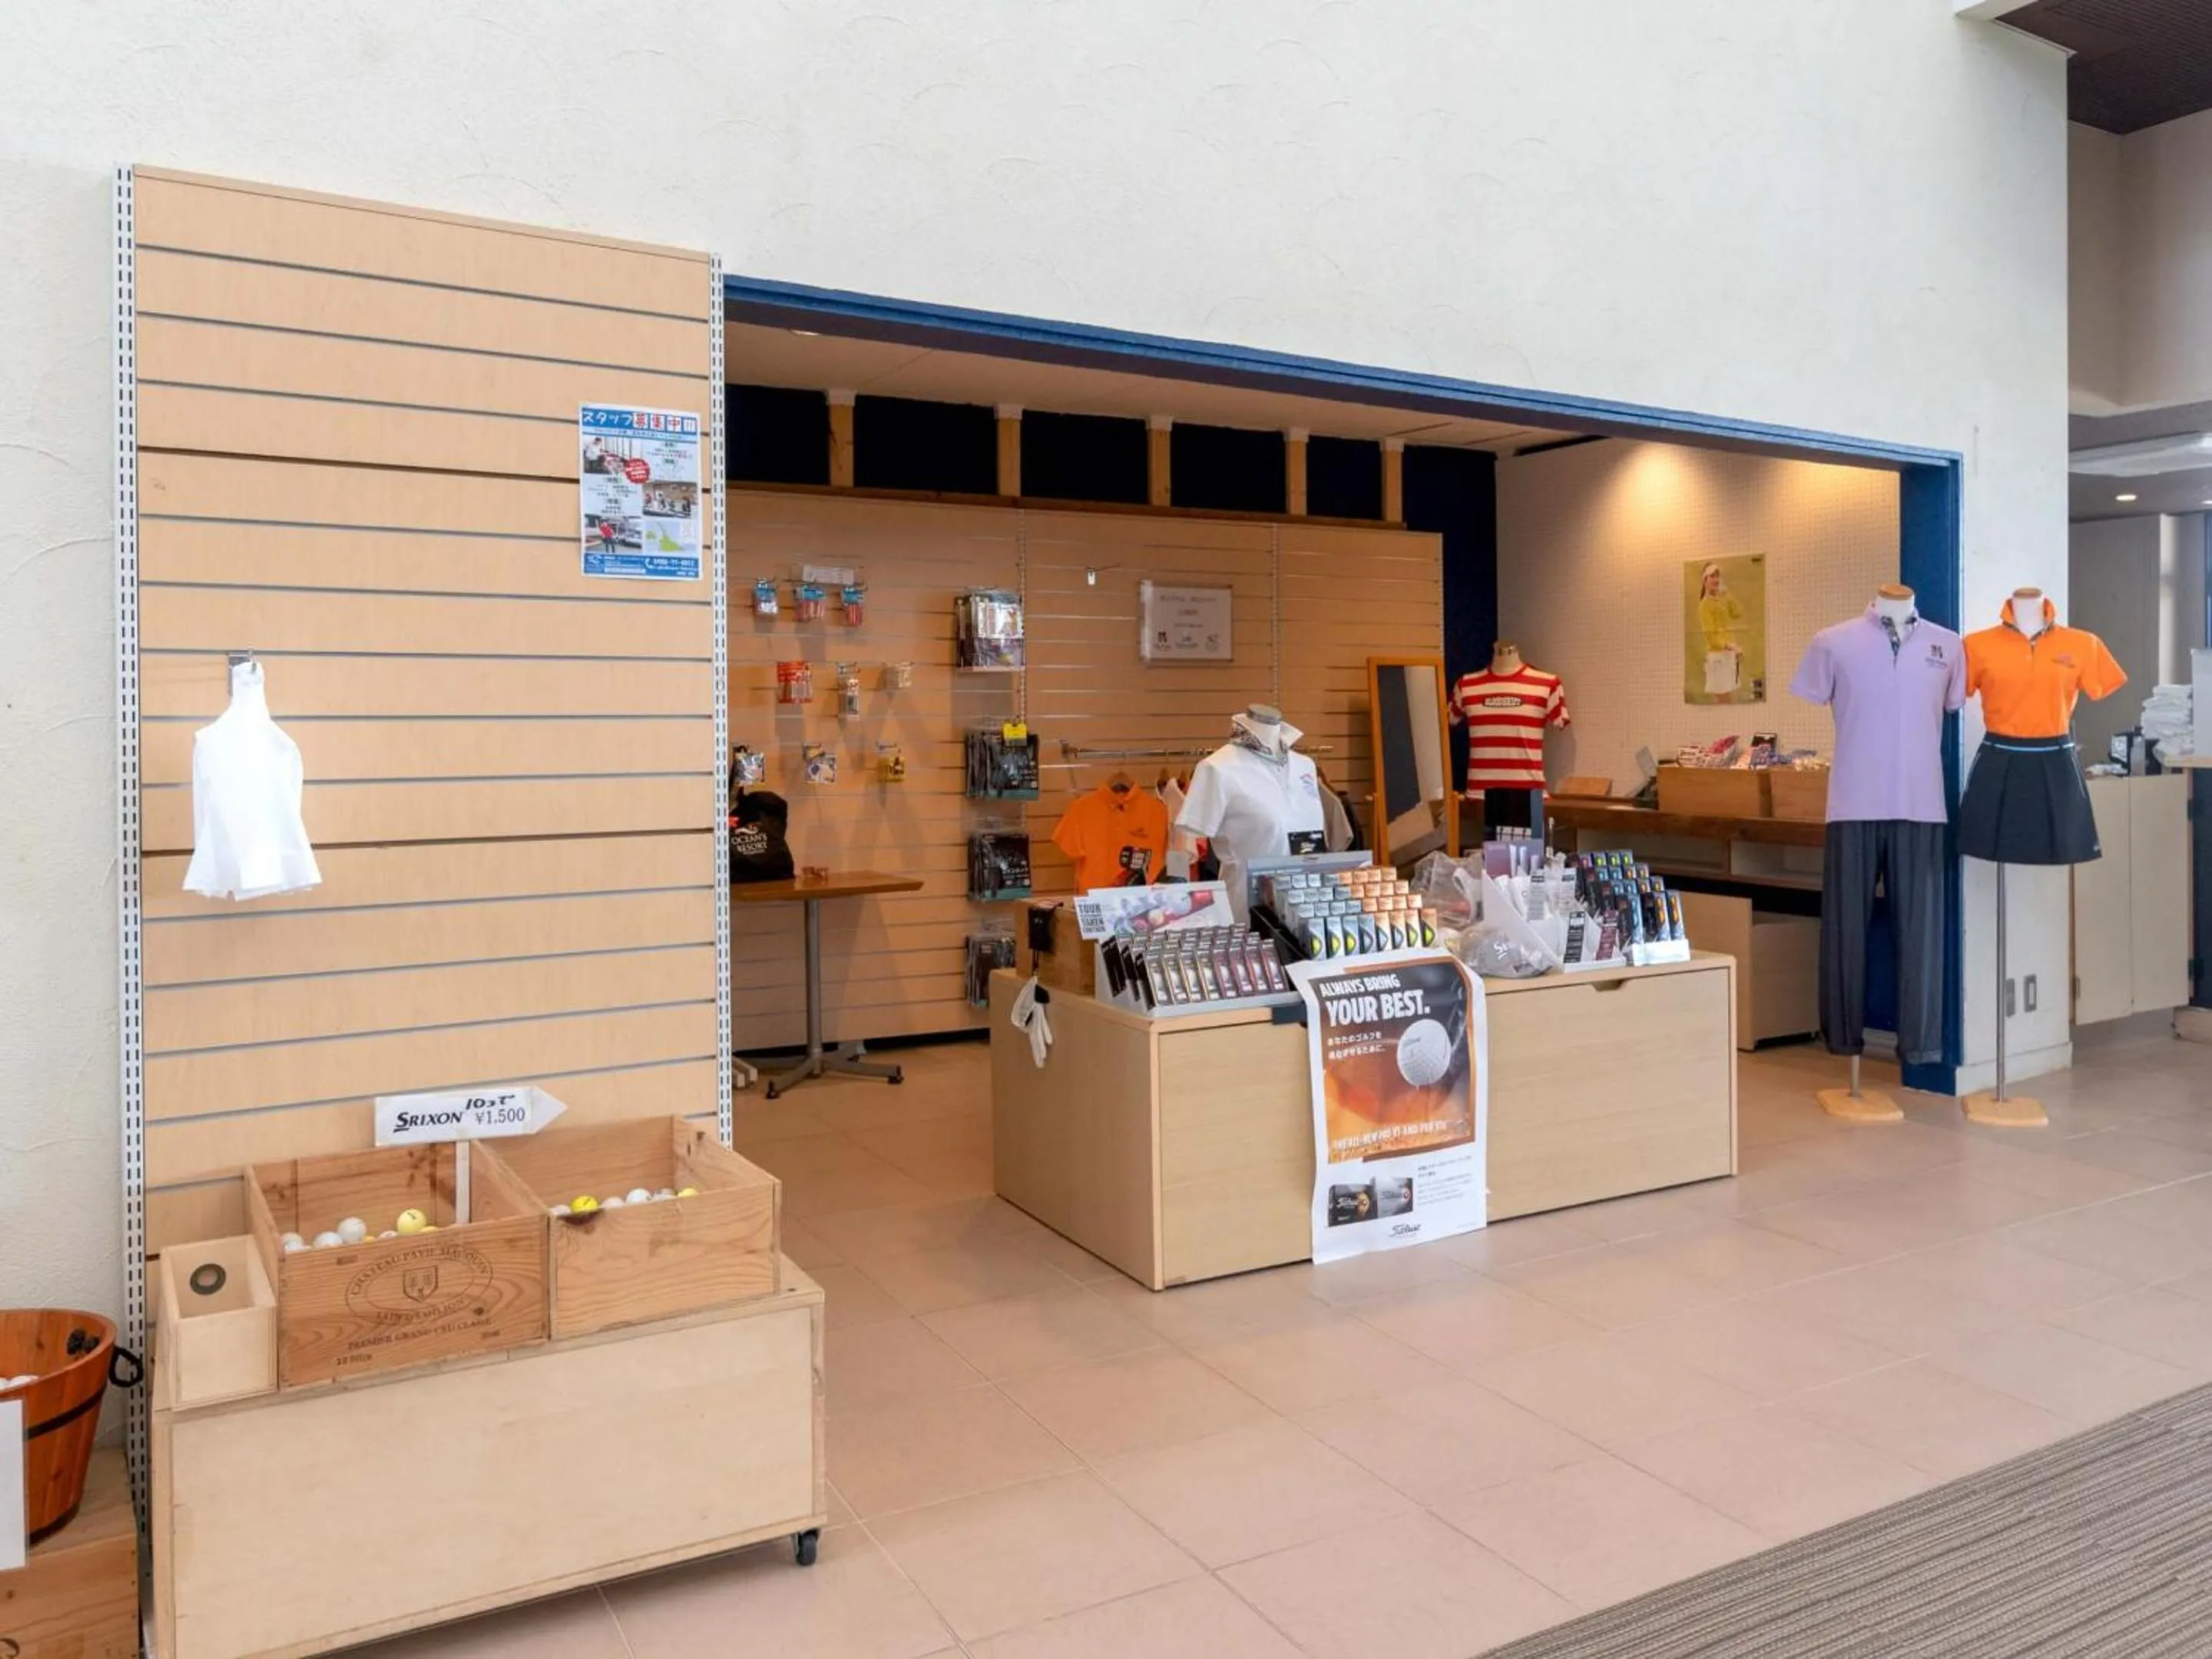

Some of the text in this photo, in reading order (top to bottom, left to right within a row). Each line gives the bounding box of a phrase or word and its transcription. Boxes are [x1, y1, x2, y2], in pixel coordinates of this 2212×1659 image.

[1319, 973, 1401, 997] ALWAYS BRING
[1325, 988, 1431, 1027] YOUR BEST.
[393, 1111, 462, 1133] SRIXON
